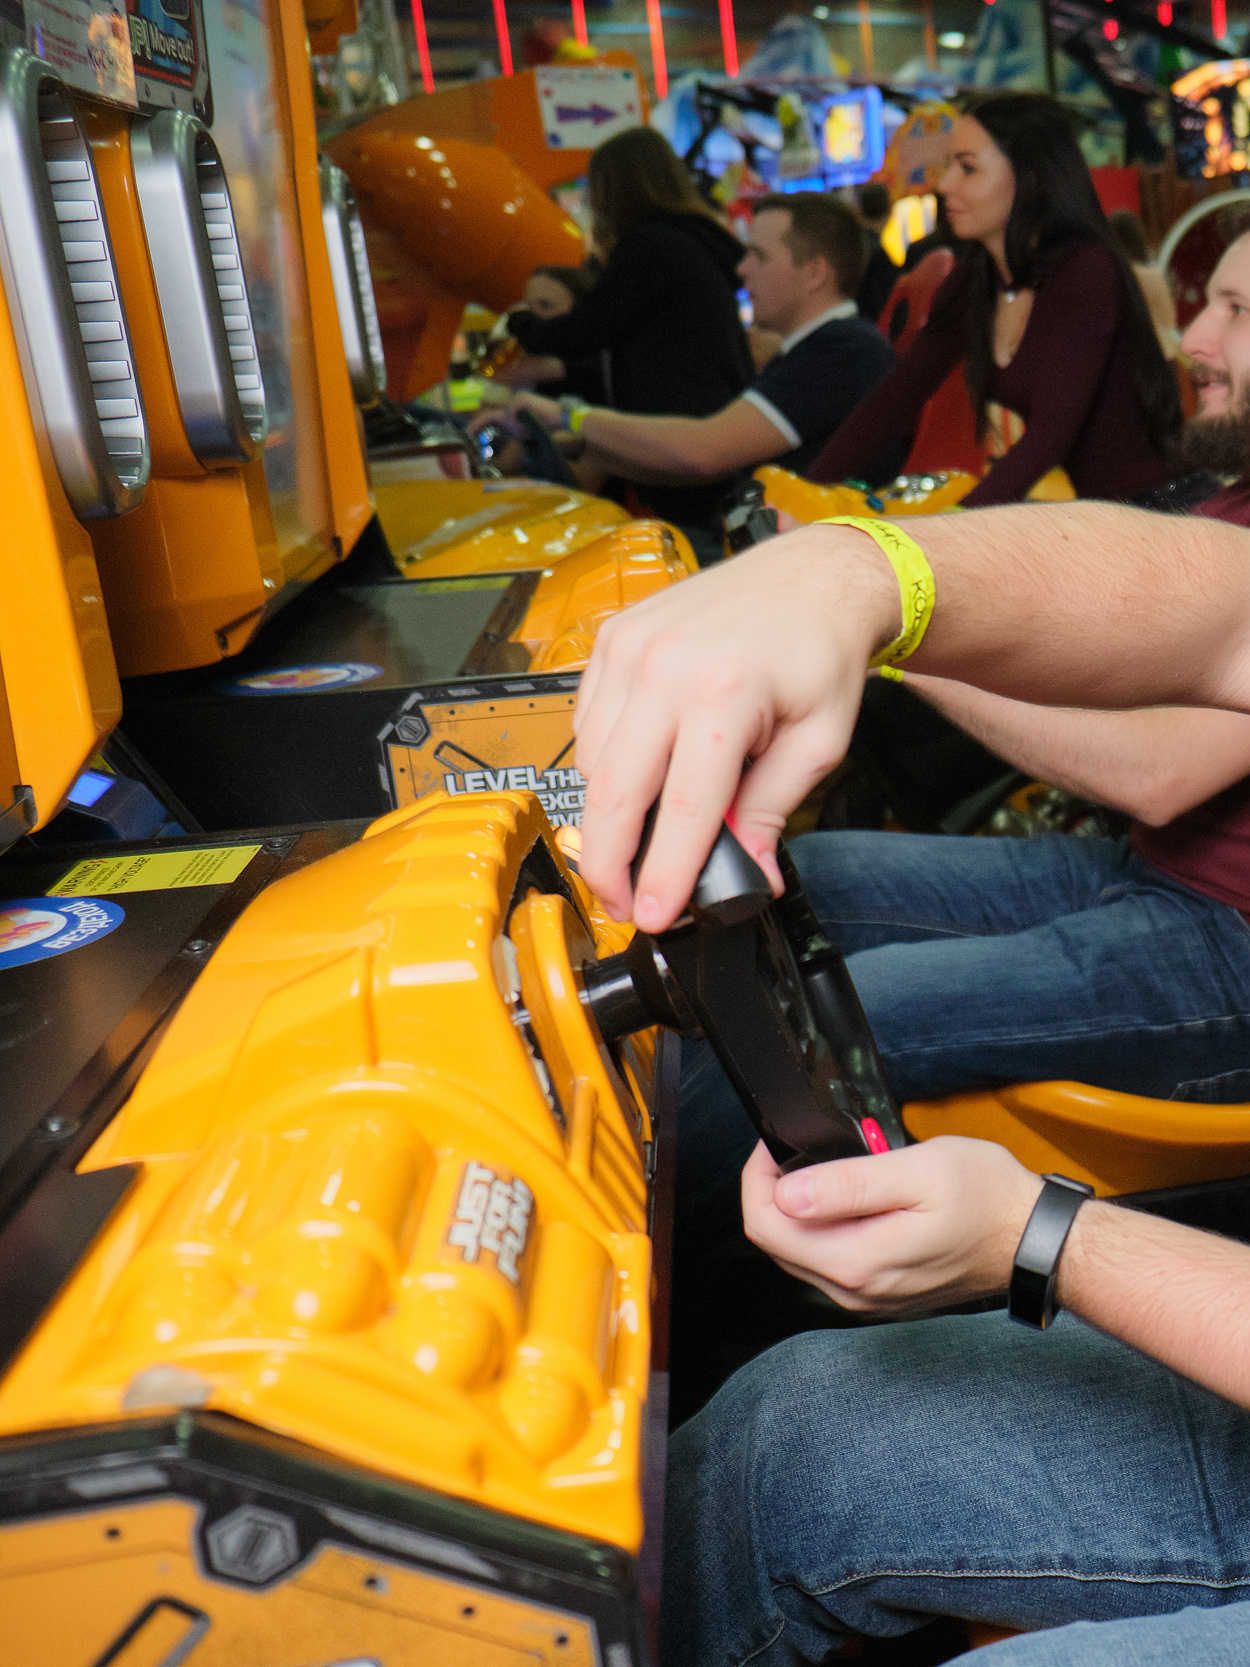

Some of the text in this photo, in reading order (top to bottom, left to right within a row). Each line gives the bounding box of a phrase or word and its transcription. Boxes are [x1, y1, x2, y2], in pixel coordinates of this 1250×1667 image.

[445, 766, 547, 797] LEVEL
[41, 901, 114, 949] ВЕЗДЕХОД
[448, 1160, 495, 1263] JUST
[480, 1179, 514, 1254] FOR
